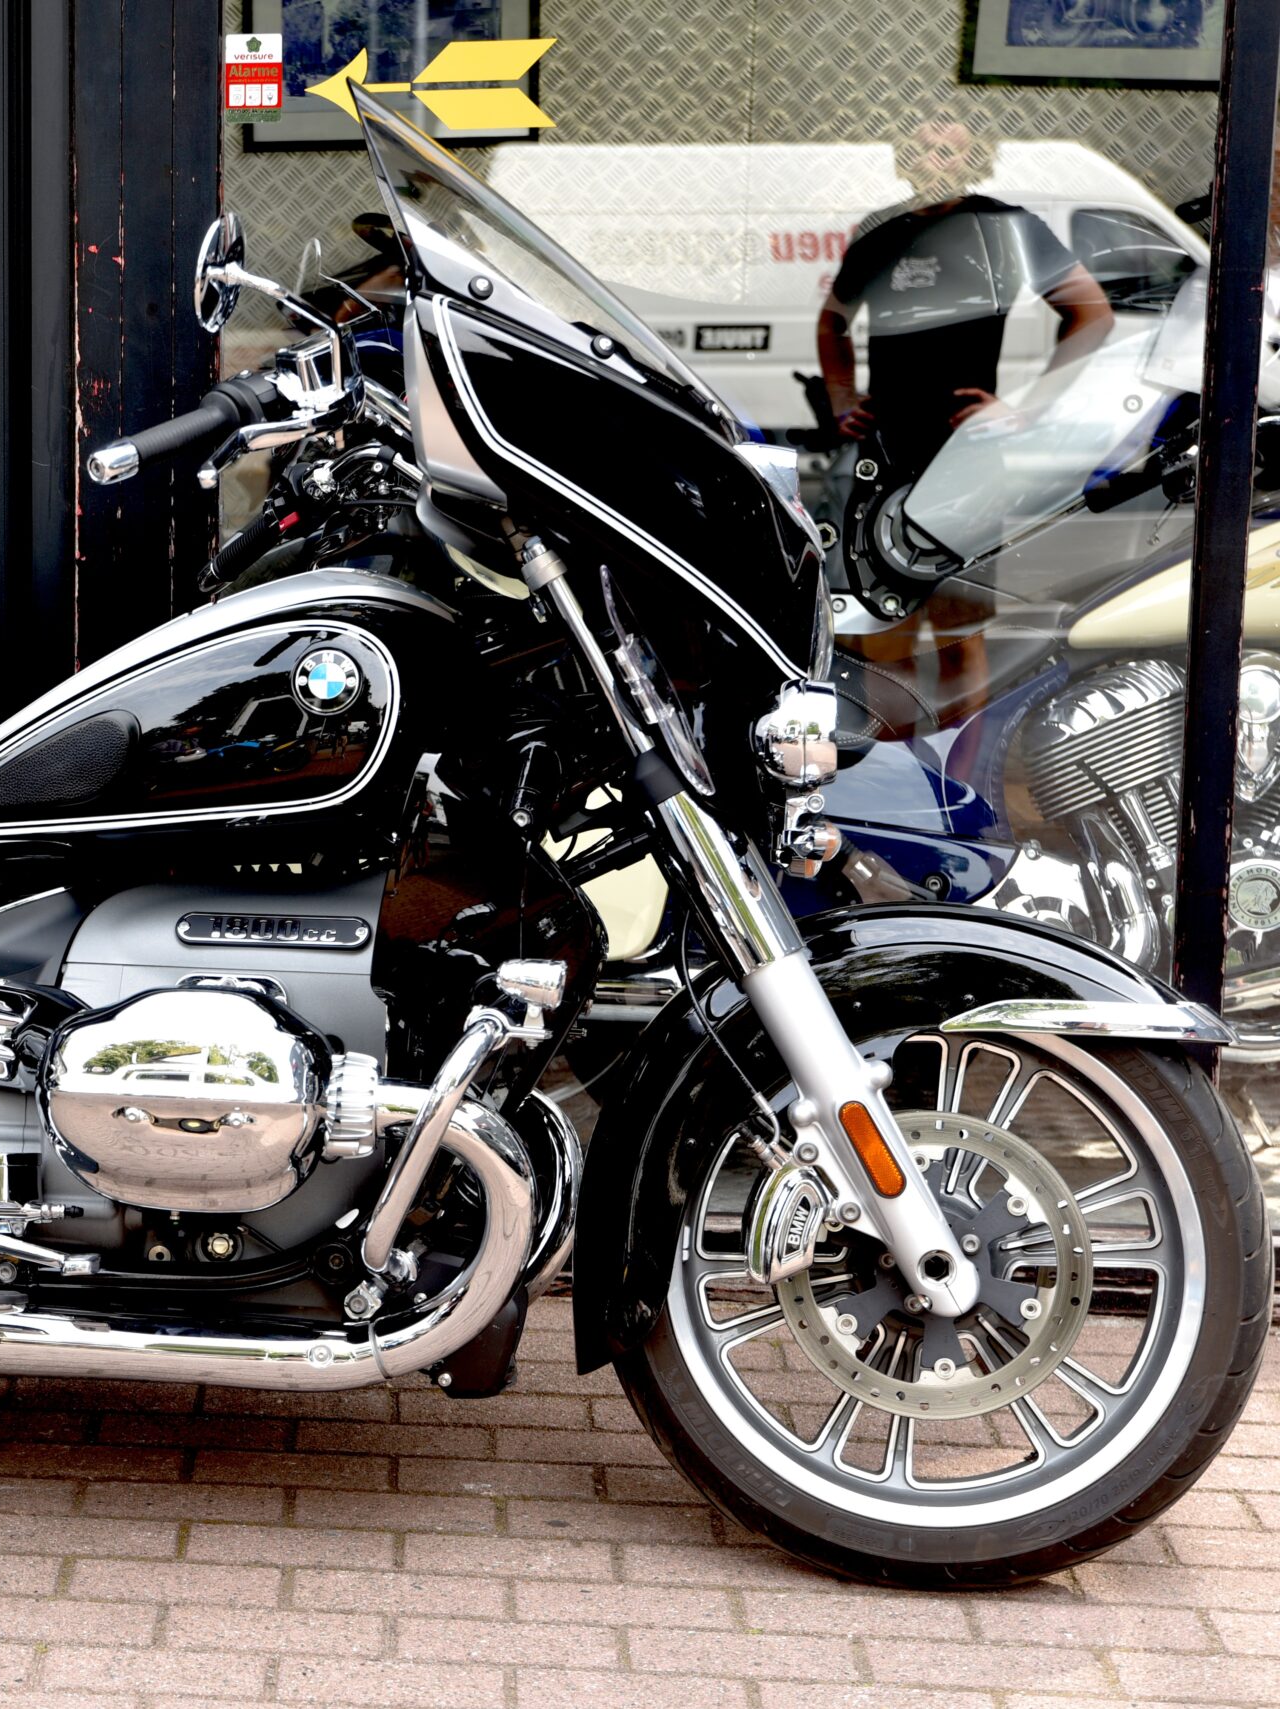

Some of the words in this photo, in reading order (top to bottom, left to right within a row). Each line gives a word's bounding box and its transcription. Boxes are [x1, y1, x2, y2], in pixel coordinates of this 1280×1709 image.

[229, 65, 279, 77] Alarme
[303, 652, 354, 673] BMW
[1229, 874, 1243, 913] INDIAN
[1246, 867, 1280, 881] MOTO
[786, 1205, 810, 1246] BMW
